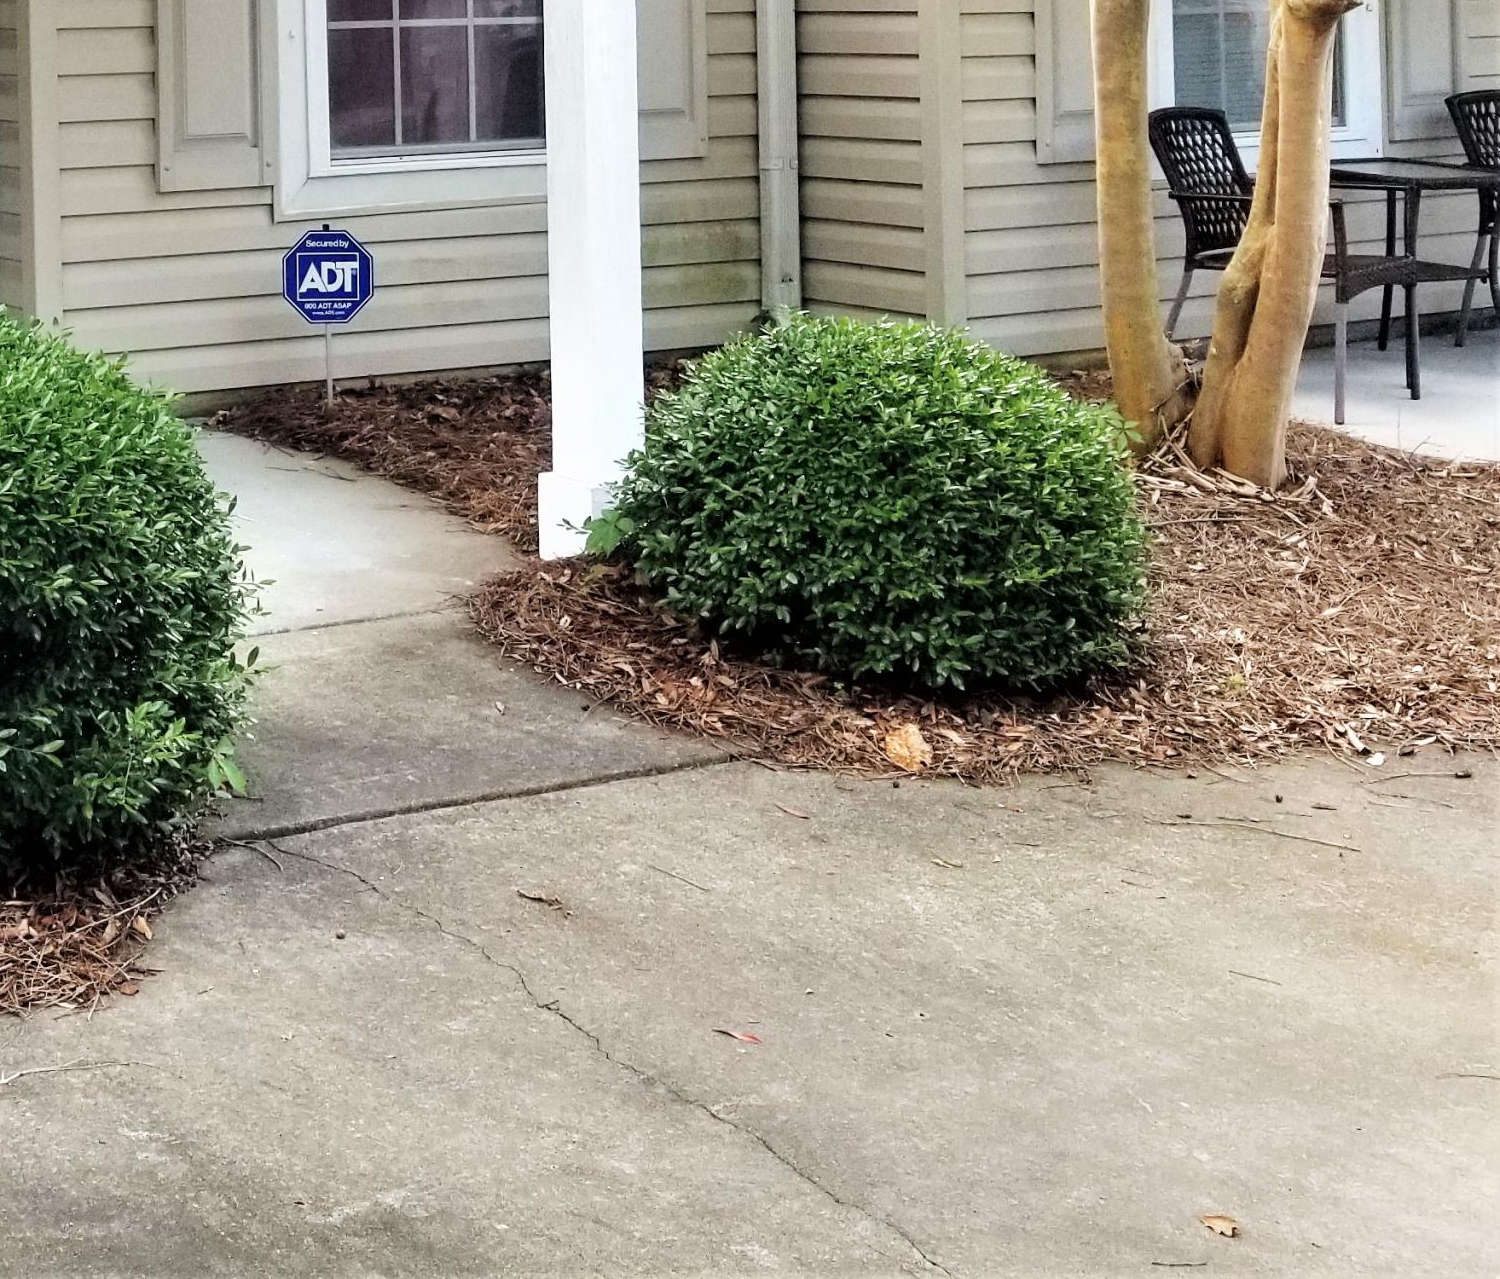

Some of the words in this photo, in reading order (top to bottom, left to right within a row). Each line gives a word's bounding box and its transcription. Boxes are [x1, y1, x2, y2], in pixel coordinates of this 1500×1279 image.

[305, 239, 339, 248] Secured
[339, 239, 350, 249] by
[299, 261, 358, 293] ADT
[317, 302, 333, 310] ADT
